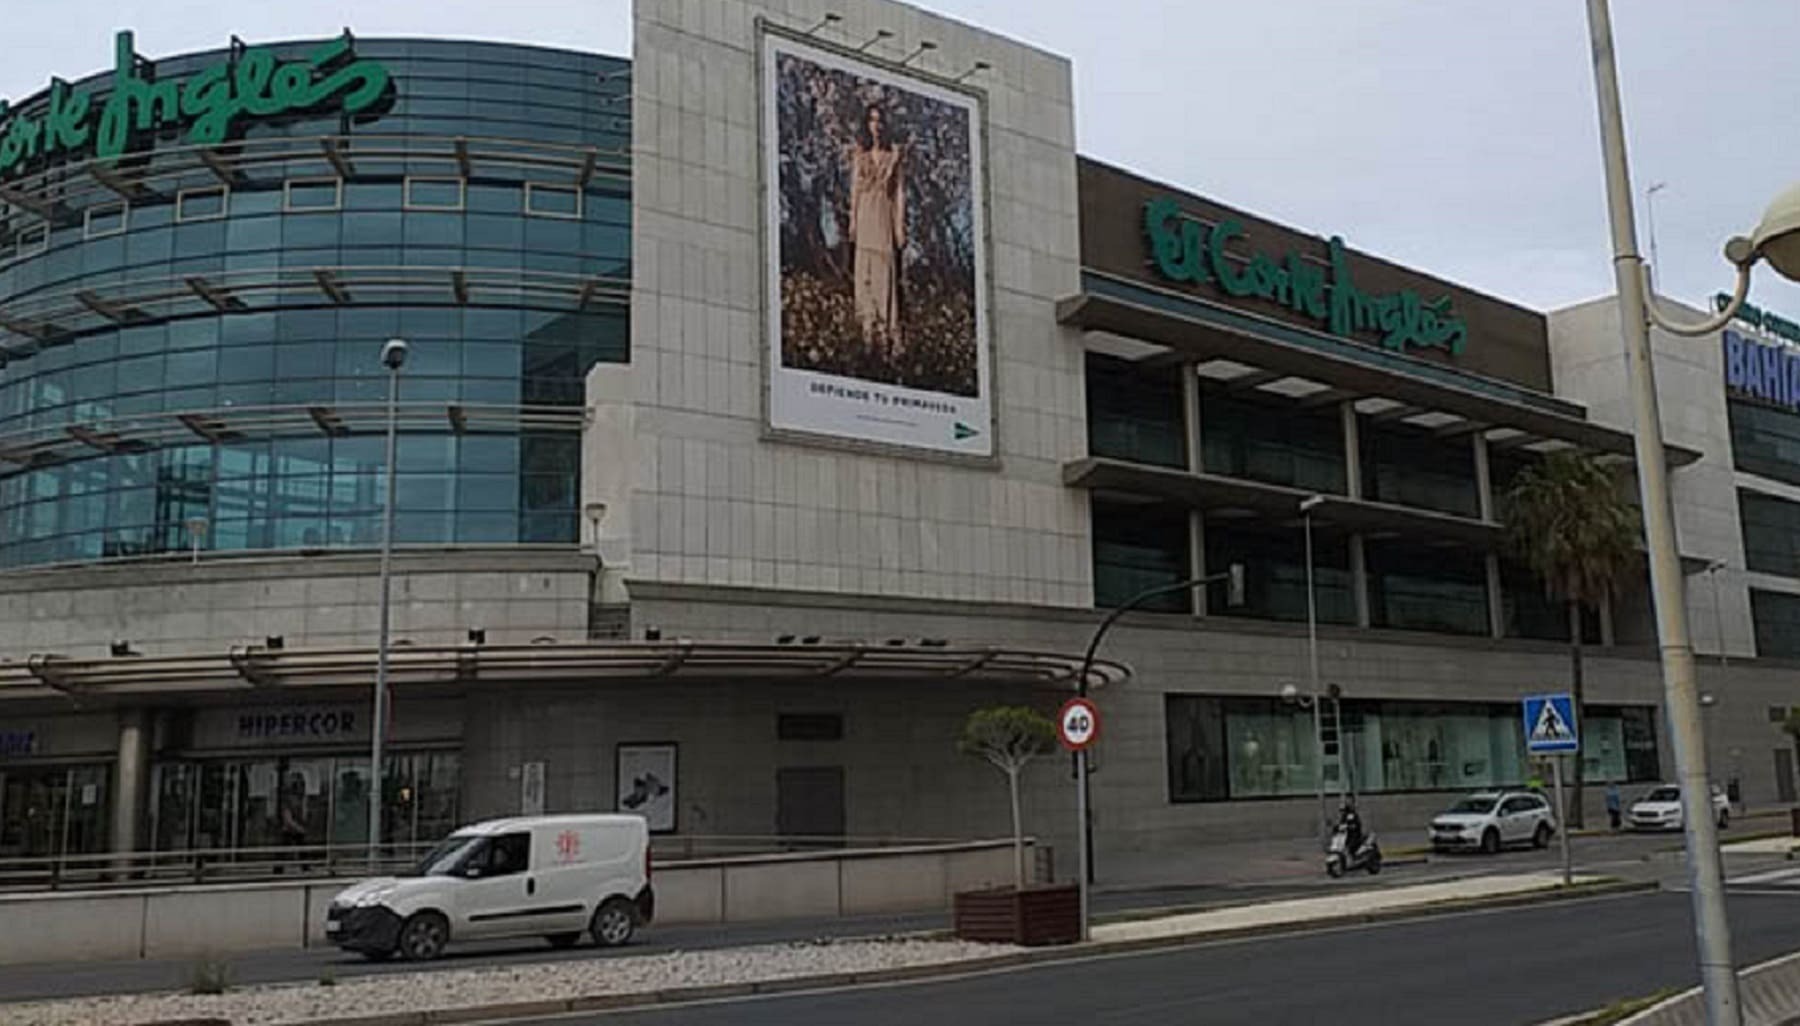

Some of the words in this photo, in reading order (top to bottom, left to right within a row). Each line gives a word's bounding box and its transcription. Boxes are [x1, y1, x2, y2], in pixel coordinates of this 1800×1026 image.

[0, 82, 89, 168] orte
[97, 31, 390, 165] Inglés
[1145, 197, 1206, 283] El
[1210, 220, 1326, 318] Corte
[1328, 235, 1467, 355] Inglés
[239, 711, 355, 736] HIPERCOR
[1067, 715, 1089, 732] 40
